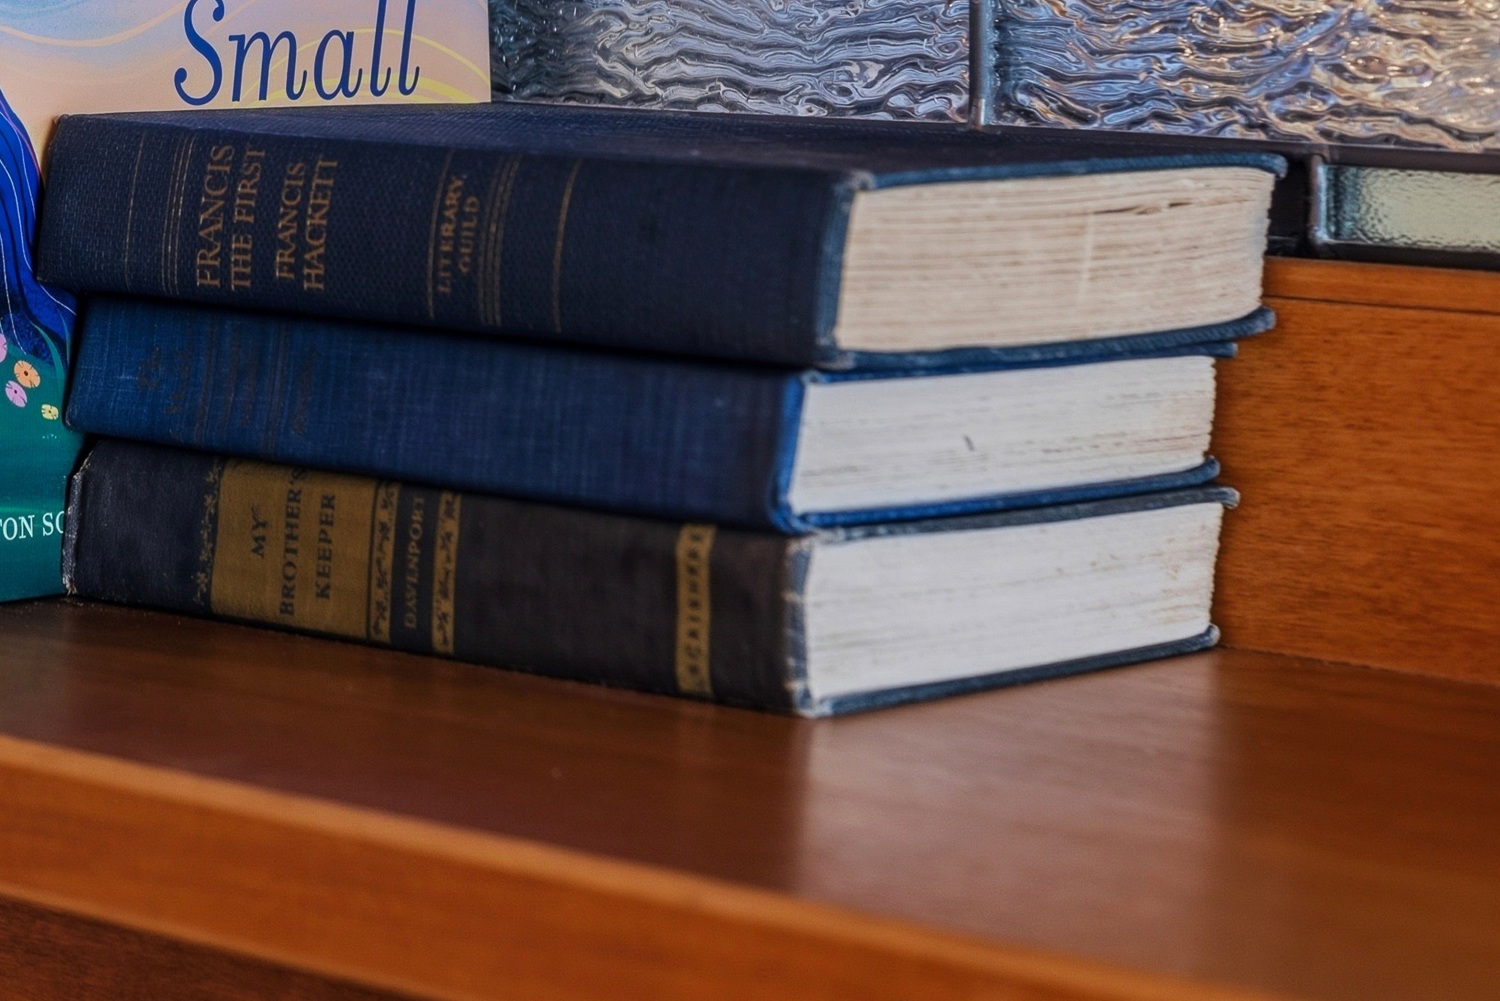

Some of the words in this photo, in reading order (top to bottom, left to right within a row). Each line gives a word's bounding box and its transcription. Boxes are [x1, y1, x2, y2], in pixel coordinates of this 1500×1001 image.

[196, 143, 235, 288] FRANCIS
[234, 144, 265, 226] FIRST
[275, 162, 305, 281] FRANCIS
[303, 155, 338, 291] HACKETT
[230, 233, 253, 292] THE
[251, 504, 269, 559] MY
[280, 467, 308, 616] BROTHER'S
[316, 494, 336, 600] KEEPER
